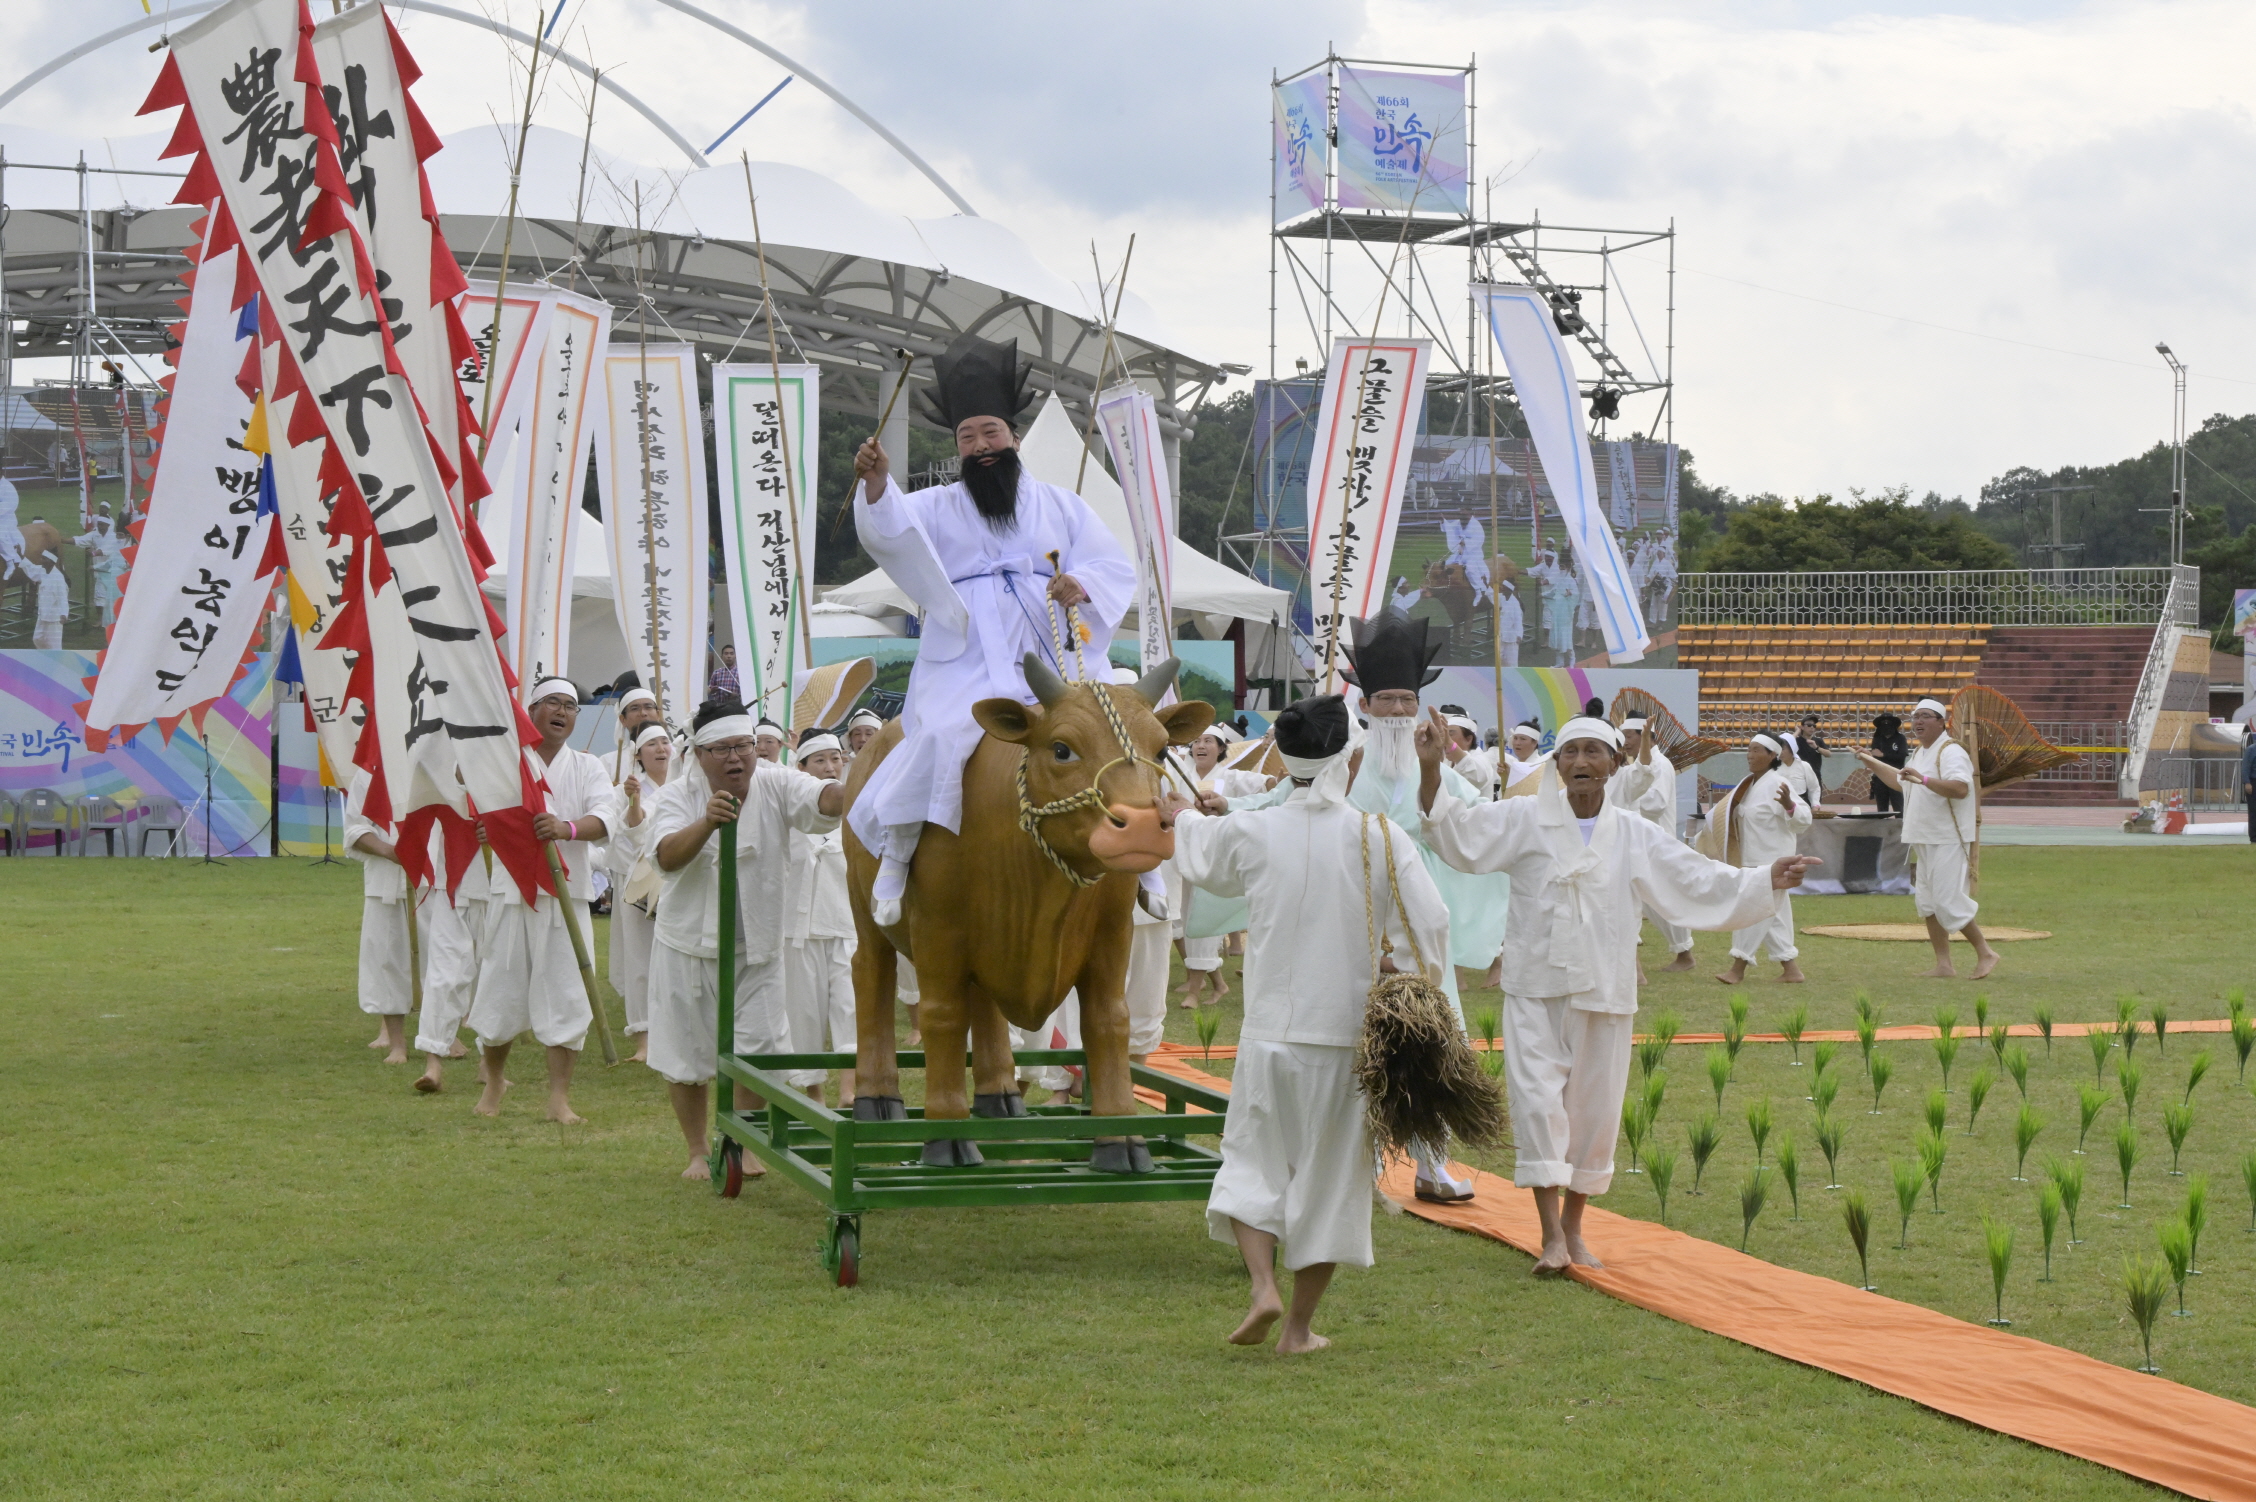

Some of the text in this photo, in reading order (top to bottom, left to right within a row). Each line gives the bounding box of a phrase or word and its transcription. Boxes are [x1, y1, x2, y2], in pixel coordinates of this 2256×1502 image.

[1375, 109, 1396, 120] 한국
[1376, 96, 1409, 108] 제66회
[1373, 112, 1431, 173] 민속
[1374, 158, 1407, 170] 예술제
[1352, 358, 1392, 433] 그물을
[752, 401, 786, 497] 달떠온다
[1320, 521, 1360, 600] 그물을
[22, 720, 81, 773] 민속
